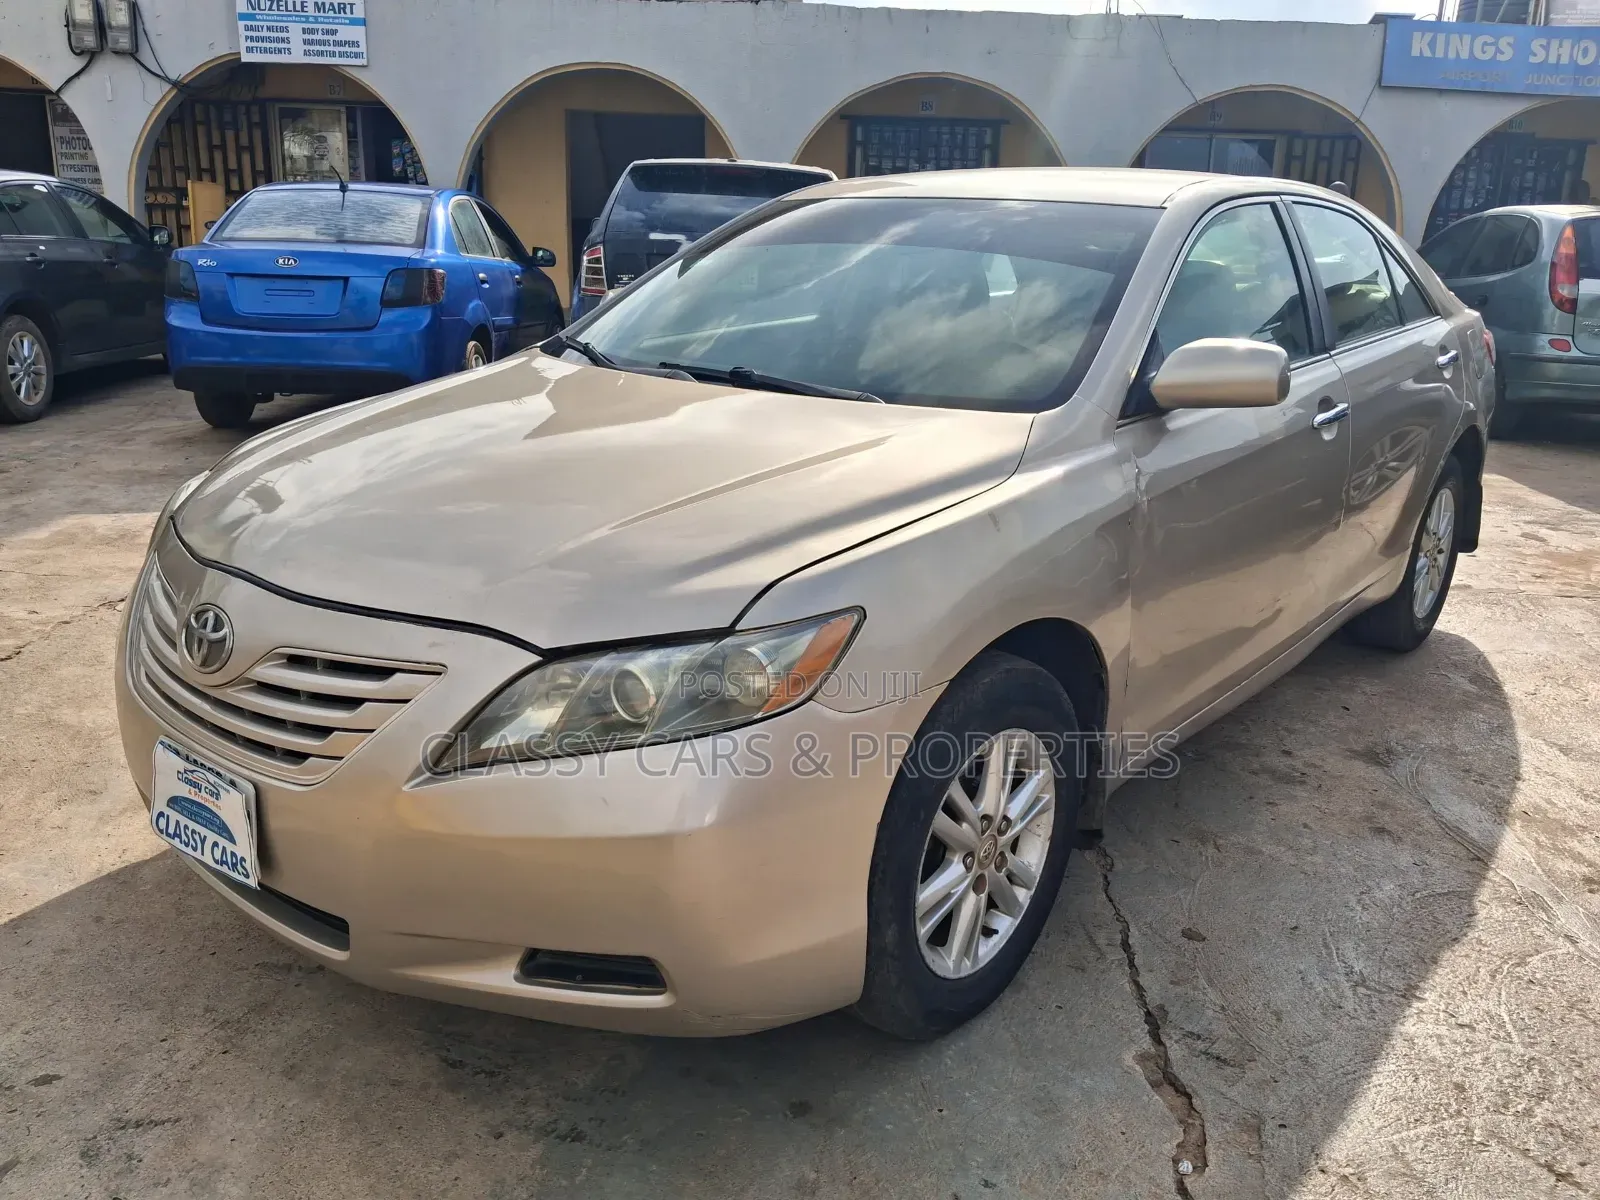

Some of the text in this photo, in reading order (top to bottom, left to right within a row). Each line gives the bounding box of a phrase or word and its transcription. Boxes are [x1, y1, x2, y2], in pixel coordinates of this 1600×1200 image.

[314, 1, 356, 15] MART
[244, 24, 290, 34] DAILY NEEDS
[302, 27, 339, 37] BODY SHOP
[245, 35, 291, 45] PROVISIONS
[302, 37, 360, 49] VARIOUS DIAPERS
[303, 48, 337, 58] ASSORTED
[1411, 31, 1600, 66] KINGS SHO
[1523, 73, 1600, 88] JUNCTIO
[197, 258, 217, 266] Rio
[155, 810, 250, 880] CLASSY CARS
